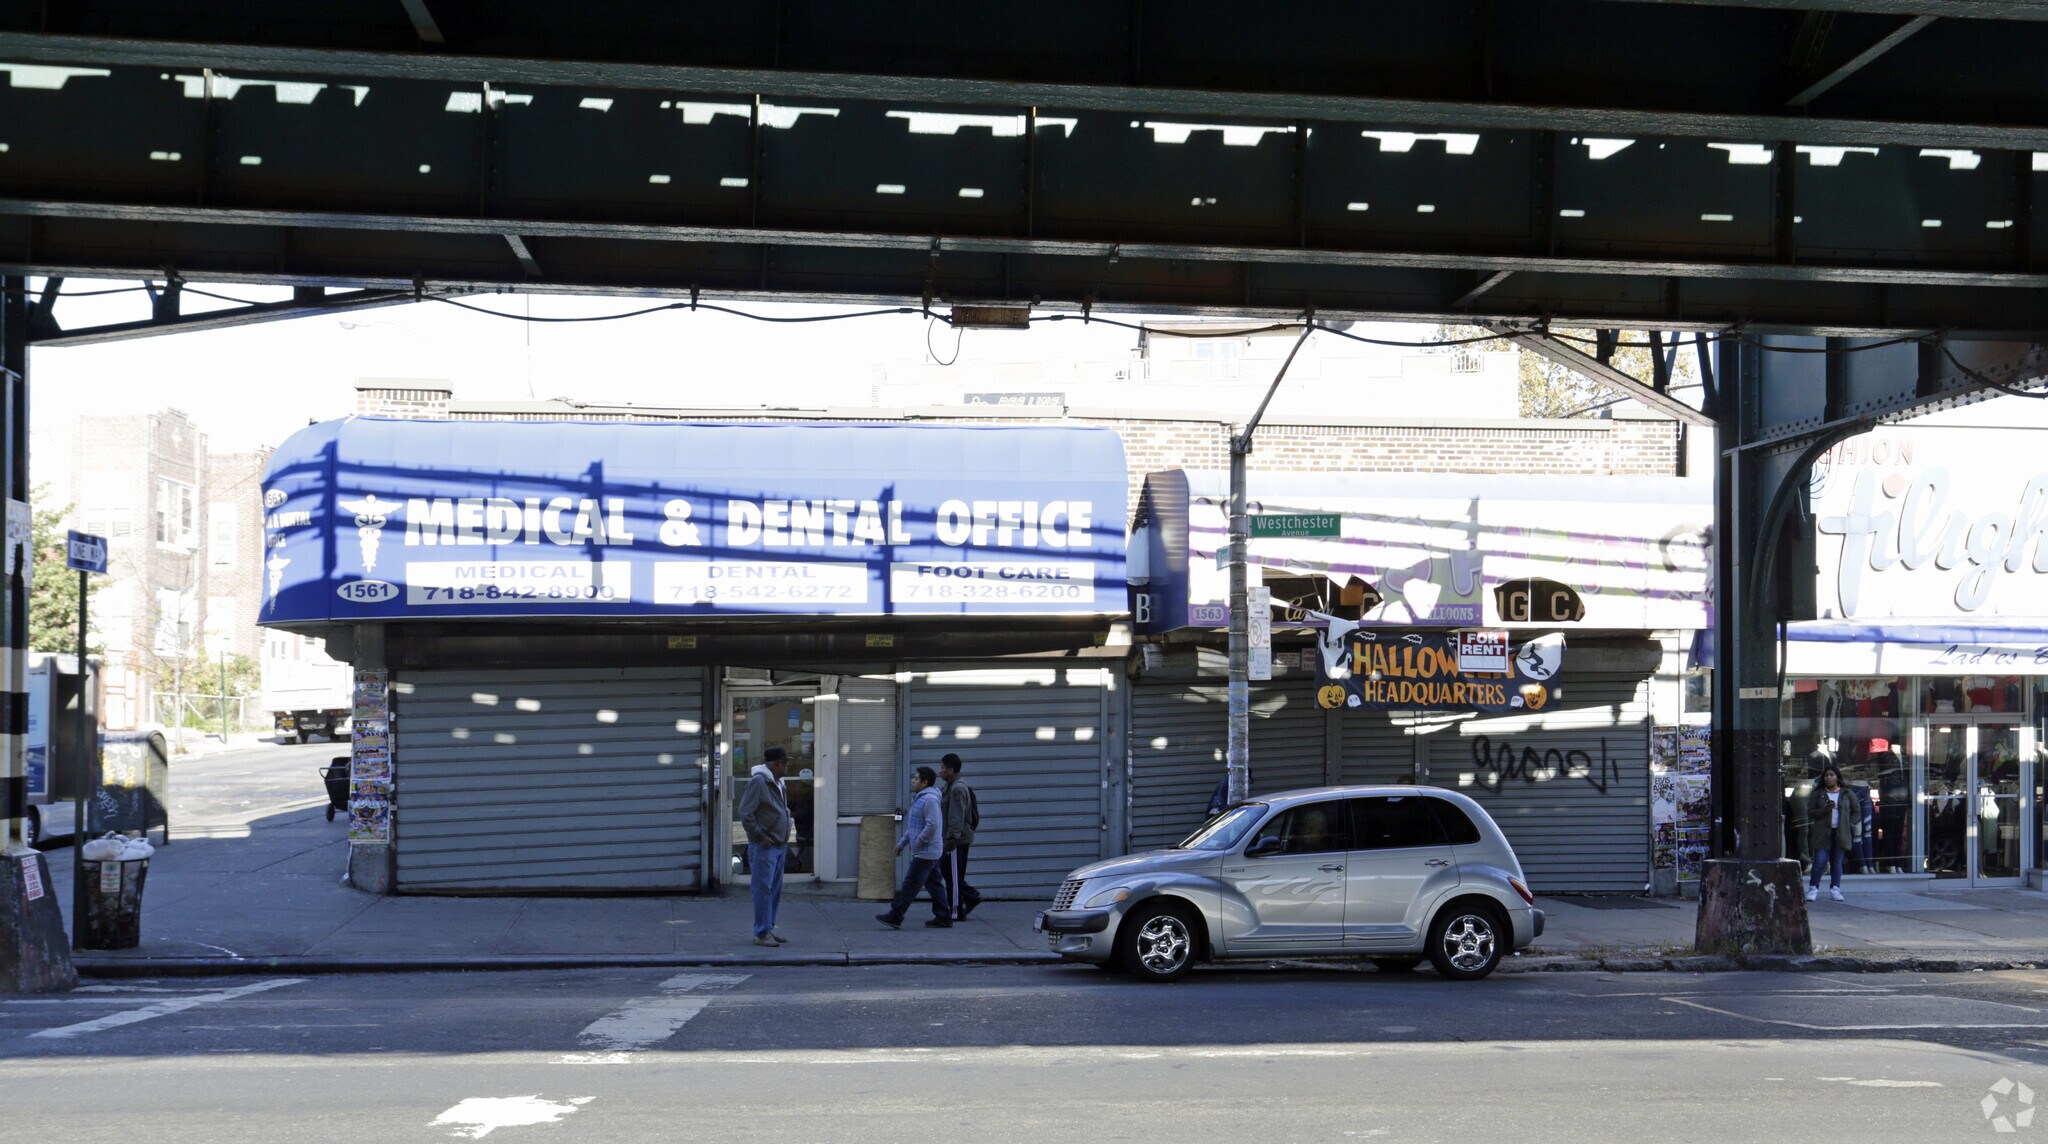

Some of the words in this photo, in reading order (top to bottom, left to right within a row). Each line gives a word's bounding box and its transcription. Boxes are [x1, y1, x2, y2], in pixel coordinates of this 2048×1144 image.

[265, 492, 284, 505] 561
[405, 497, 633, 546] MEDICAL
[660, 499, 702, 547] &
[728, 500, 911, 546] DENTAL
[936, 500, 1092, 548] OFFICE
[1256, 515, 1335, 530] Westchester
[1281, 529, 1310, 537] Avenue
[455, 565, 585, 579] MEDICAL
[707, 566, 817, 580] DENTAL
[917, 566, 985, 580] FOOT
[998, 566, 1070, 580] CARE
[343, 584, 389, 599] 1561
[423, 584, 615, 601] 718-842-8900
[670, 585, 853, 599] 718-542-6272
[907, 584, 1081, 599] 718-328-6200
[1194, 608, 1223, 620] 1563
[1466, 633, 1499, 644] FOR
[1462, 644, 1504, 655] RENT
[1928, 644, 2018, 665] Lades
[1353, 642, 1516, 679] HALLOW
[1365, 680, 1506, 706] HEADQUARTERS
